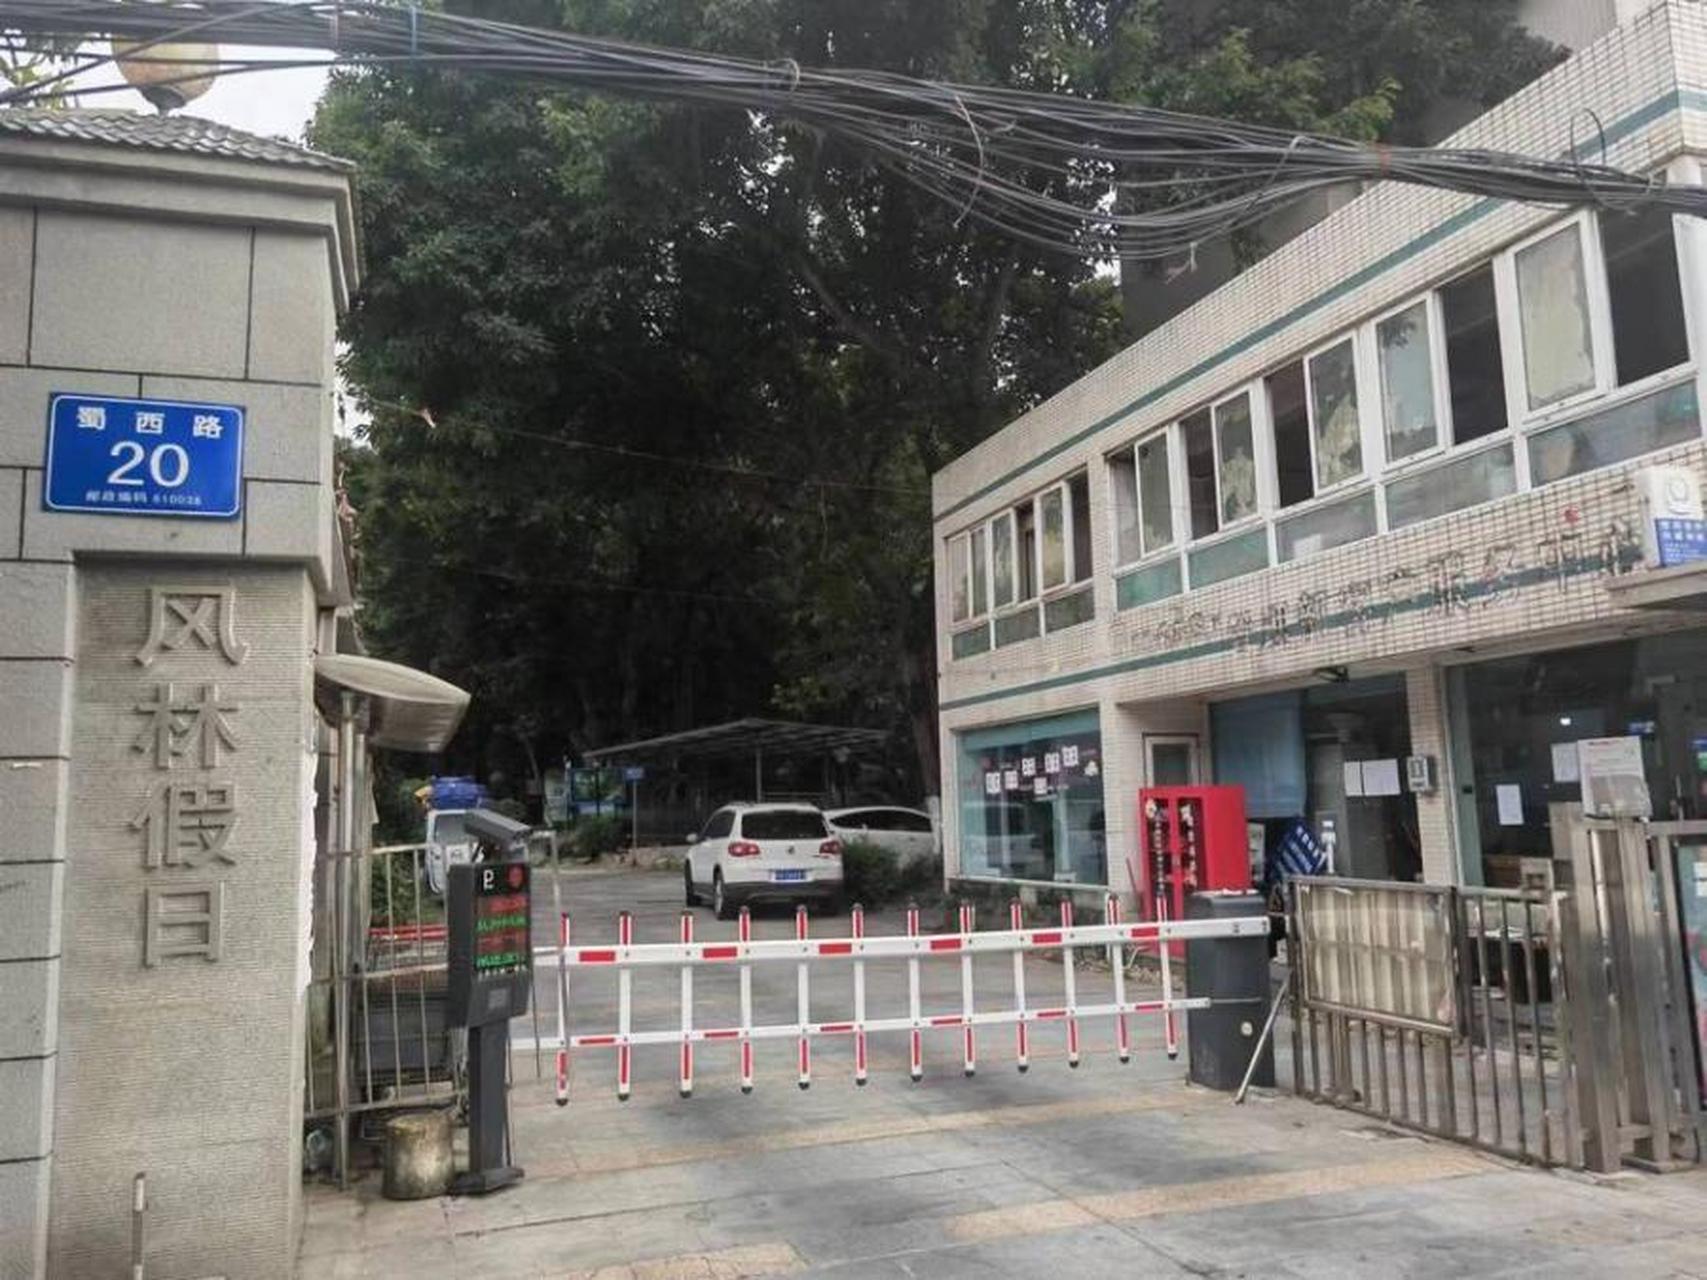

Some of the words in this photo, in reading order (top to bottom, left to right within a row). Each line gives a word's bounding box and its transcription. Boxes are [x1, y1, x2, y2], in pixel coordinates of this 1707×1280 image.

[77, 406, 223, 439] 蜀西路
[106, 441, 190, 488] 20
[131, 585, 249, 970] 风林假日
